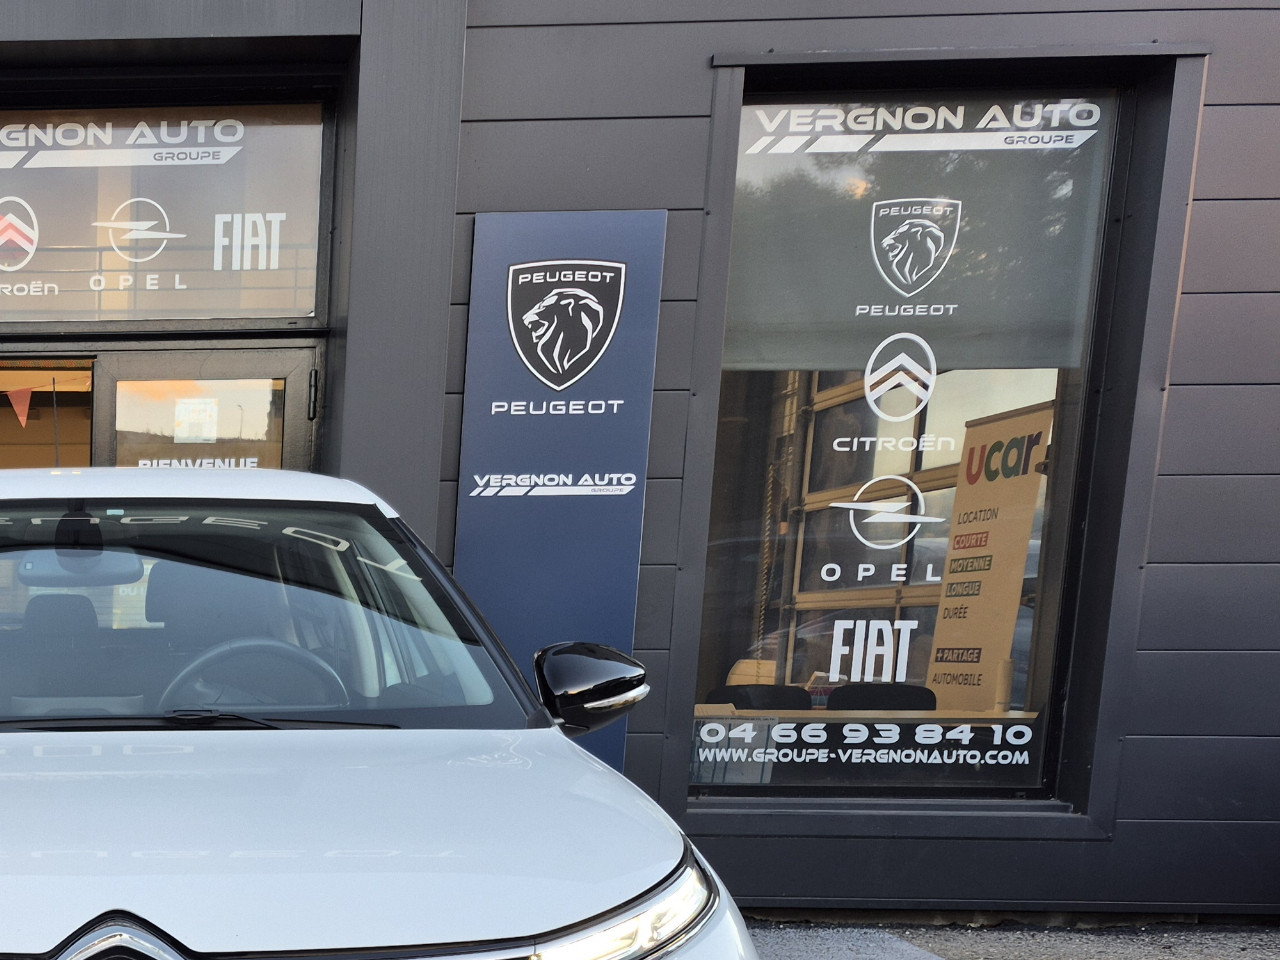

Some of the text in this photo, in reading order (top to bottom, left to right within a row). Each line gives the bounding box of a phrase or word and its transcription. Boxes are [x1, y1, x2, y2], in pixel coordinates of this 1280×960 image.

[754, 103, 1101, 132] VERGNON AUTO
[124, 119, 245, 145] AUTO
[1003, 134, 1075, 145] GROUPE
[152, 150, 221, 162] GROUPE
[878, 205, 954, 217] PEUGEOT
[213, 212, 286, 271] FIAT
[89, 274, 188, 292] OPEL
[518, 270, 615, 284] PEUGEOT
[855, 304, 959, 316] PEUGEOT
[491, 400, 625, 415] PEUGEOT
[965, 430, 1043, 485] ucar
[473, 472, 637, 487] VERGNON AUTO
[957, 508, 999, 525] LOCATION
[954, 534, 988, 548] COURTE
[820, 563, 942, 582] OPEL
[950, 557, 991, 573] MOYENNE
[946, 582, 980, 597] LONGUE
[943, 604, 969, 620] DURÉE
[828, 619, 918, 683] FIAT
[931, 673, 983, 686] AUTOMOBILE
[699, 722, 1033, 745] 04 66 93 84 10
[697, 747, 1030, 765] WWW.GROUPE-VERGNONAUTO.COM
